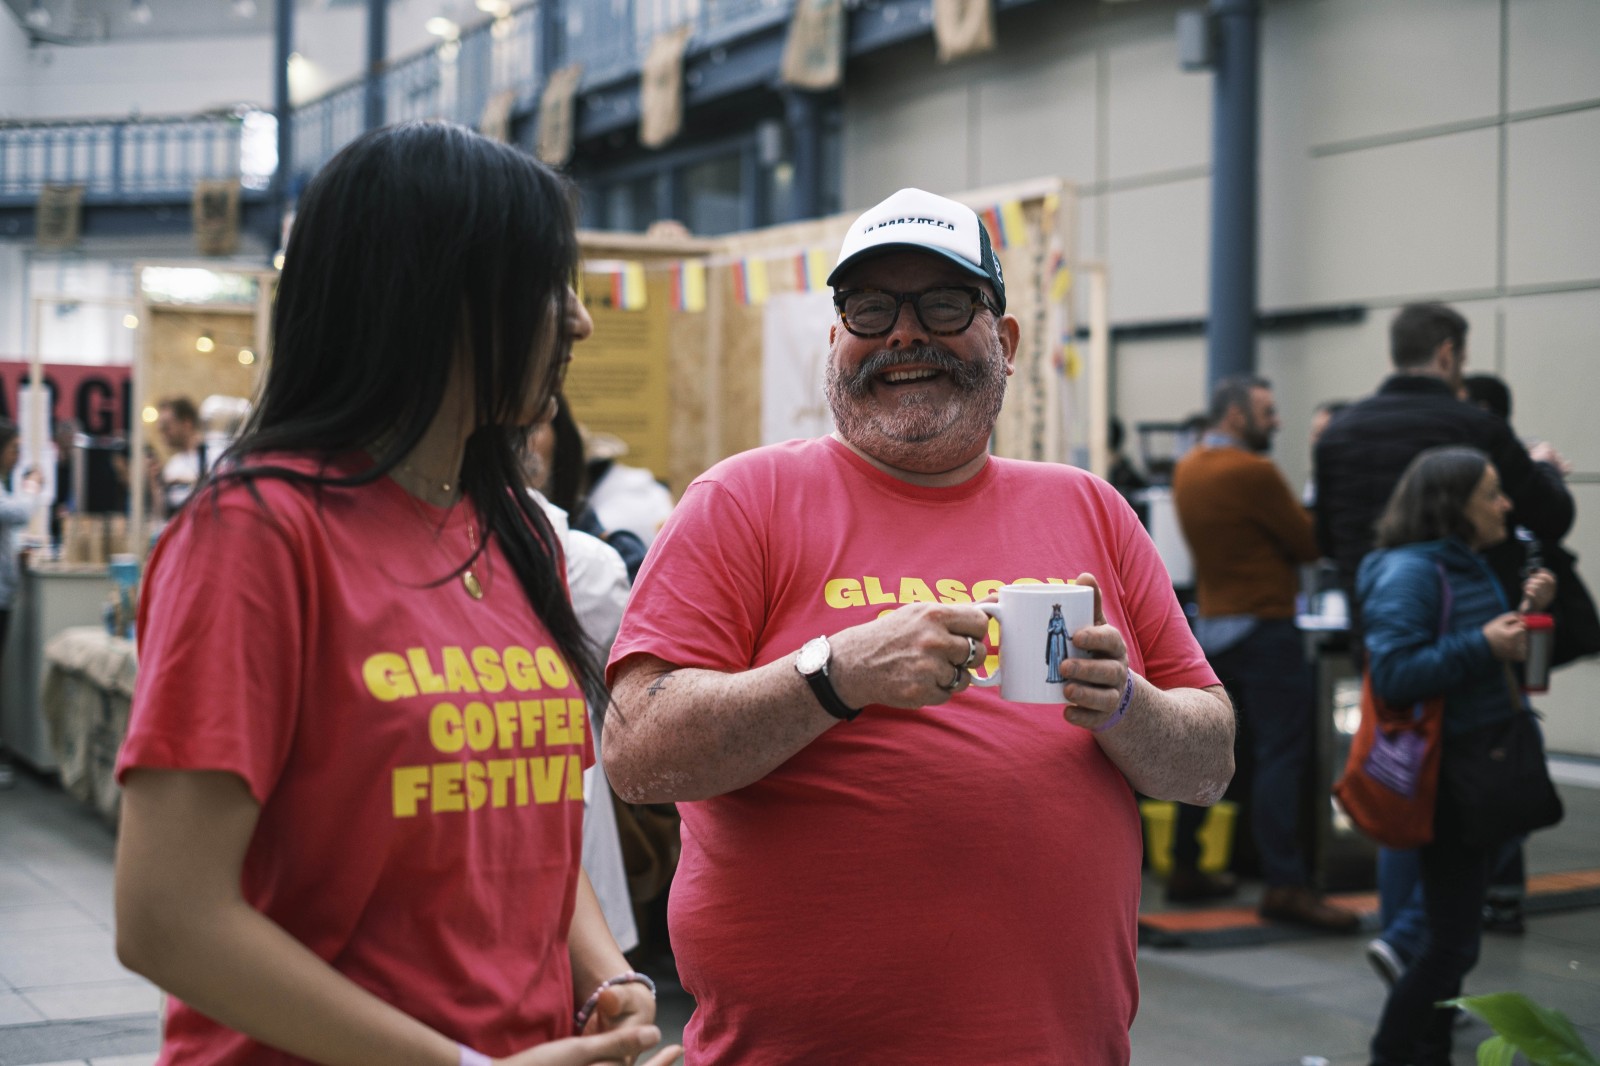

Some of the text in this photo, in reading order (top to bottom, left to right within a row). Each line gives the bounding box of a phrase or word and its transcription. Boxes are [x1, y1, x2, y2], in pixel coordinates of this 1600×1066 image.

[824, 576, 1077, 609] GLASG
[362, 646, 580, 702] GLASGO
[428, 698, 585, 753] COFFEE
[392, 755, 585, 818] FESTIVA
